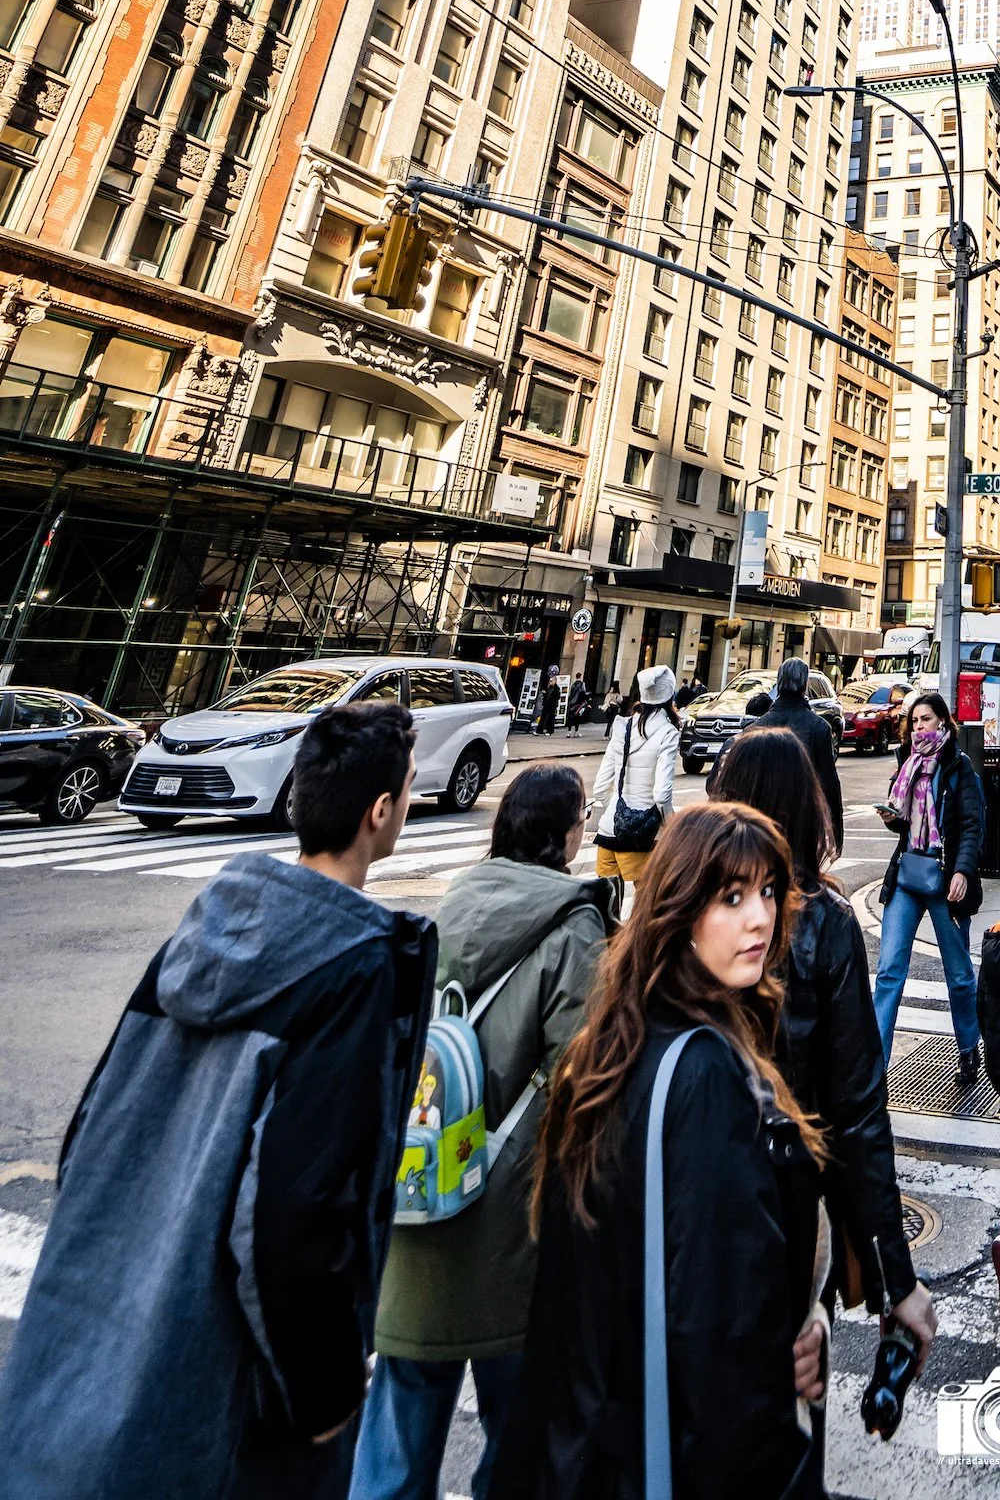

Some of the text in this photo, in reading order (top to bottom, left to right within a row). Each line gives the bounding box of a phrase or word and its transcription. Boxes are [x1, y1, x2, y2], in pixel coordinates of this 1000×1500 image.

[970, 476, 978, 492] E
[767, 578, 801, 597] MERIDIEN
[890, 635, 914, 643] Sysco
